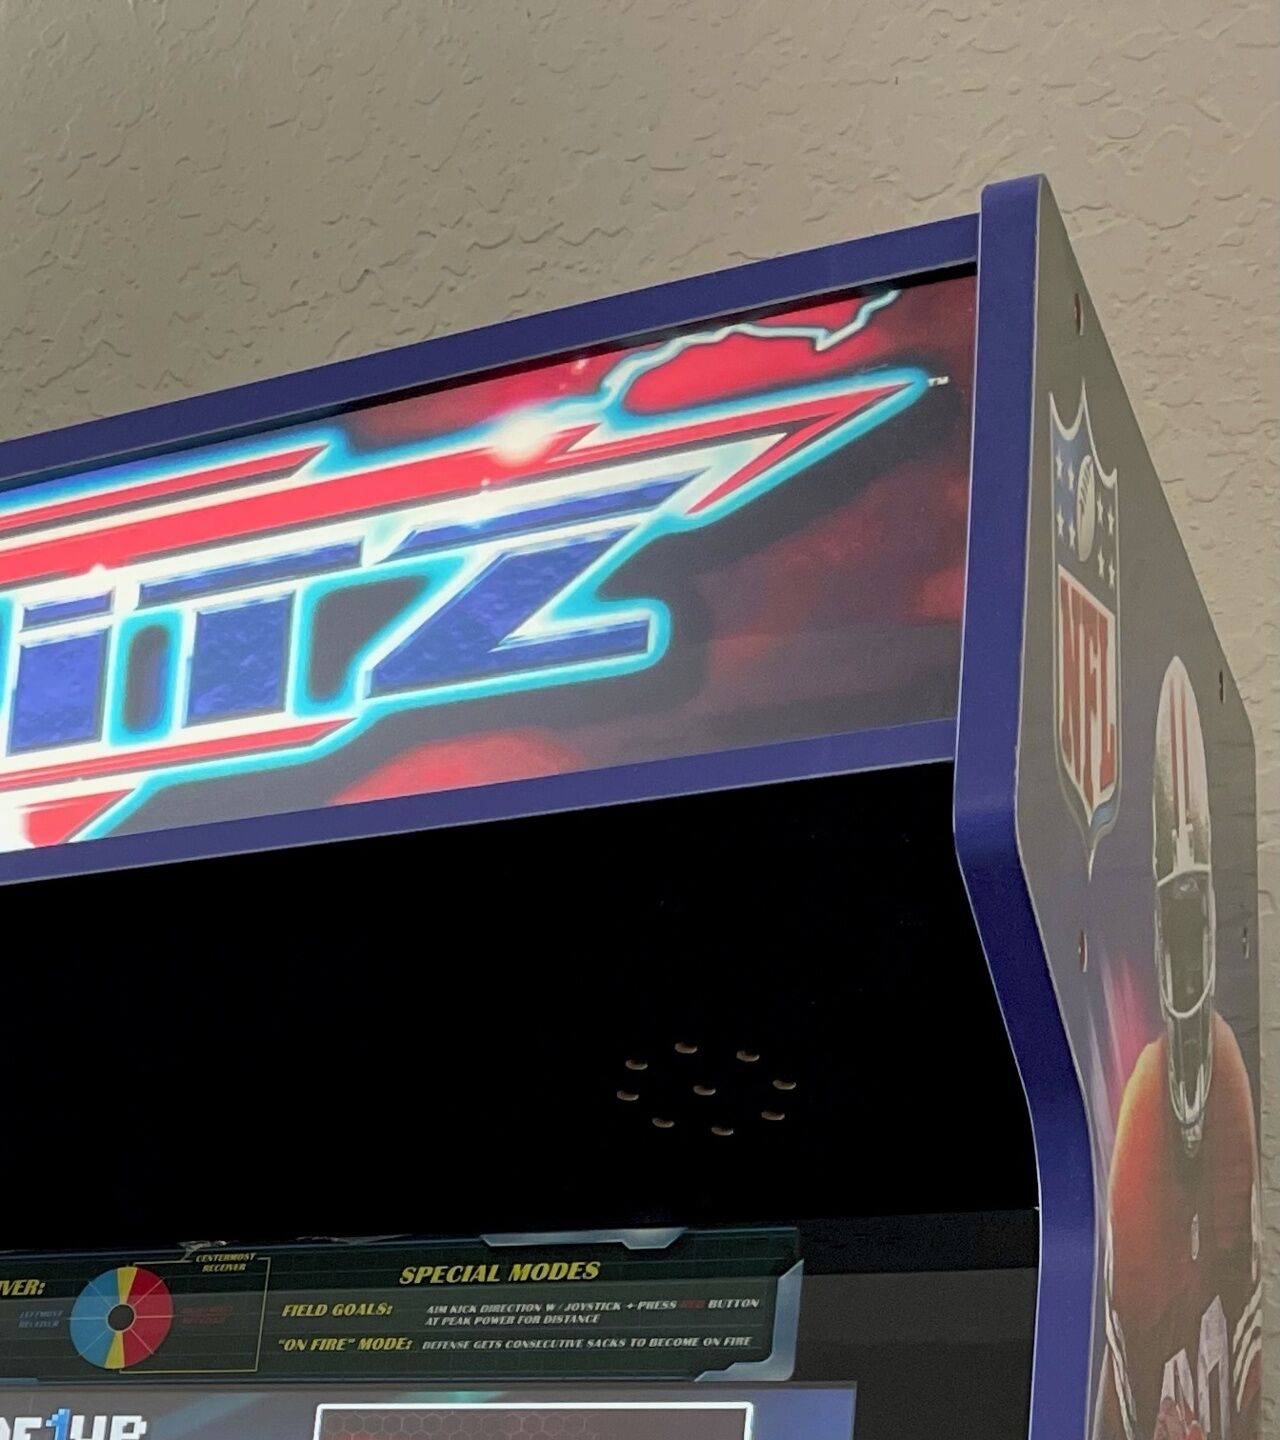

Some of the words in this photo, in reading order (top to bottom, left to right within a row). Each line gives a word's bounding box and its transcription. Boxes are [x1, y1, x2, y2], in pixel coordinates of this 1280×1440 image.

[1060, 578, 1116, 804] NFL
[399, 1264, 500, 1285] SPECIAL
[507, 1261, 601, 1282] MODES
[281, 1303, 328, 1317] FIELD
[332, 1302, 393, 1317] GOALS:
[426, 1305, 448, 1314] AIM
[450, 1304, 477, 1314] KICK
[479, 1303, 543, 1313] DIRECTION
[708, 1298, 760, 1310] BUTTON
[424, 1316, 438, 1326] AT
[441, 1315, 471, 1326] PEAK
[474, 1315, 515, 1325] POWER
[517, 1314, 541, 1325] FOR
[543, 1314, 601, 1325] DISTANCE
[357, 1337, 413, 1350] MODE:
[422, 1340, 471, 1350] DEFENSE
[473, 1339, 503, 1349] GETS
[504, 1338, 584, 1349] CONSECUTIVE
[587, 1338, 627, 1348] SACKS
[630, 1337, 646, 1348] TO
[648, 1337, 700, 1347] BECOME
[703, 1336, 721, 1346] ON
[723, 1336, 753, 1346] FIRE
